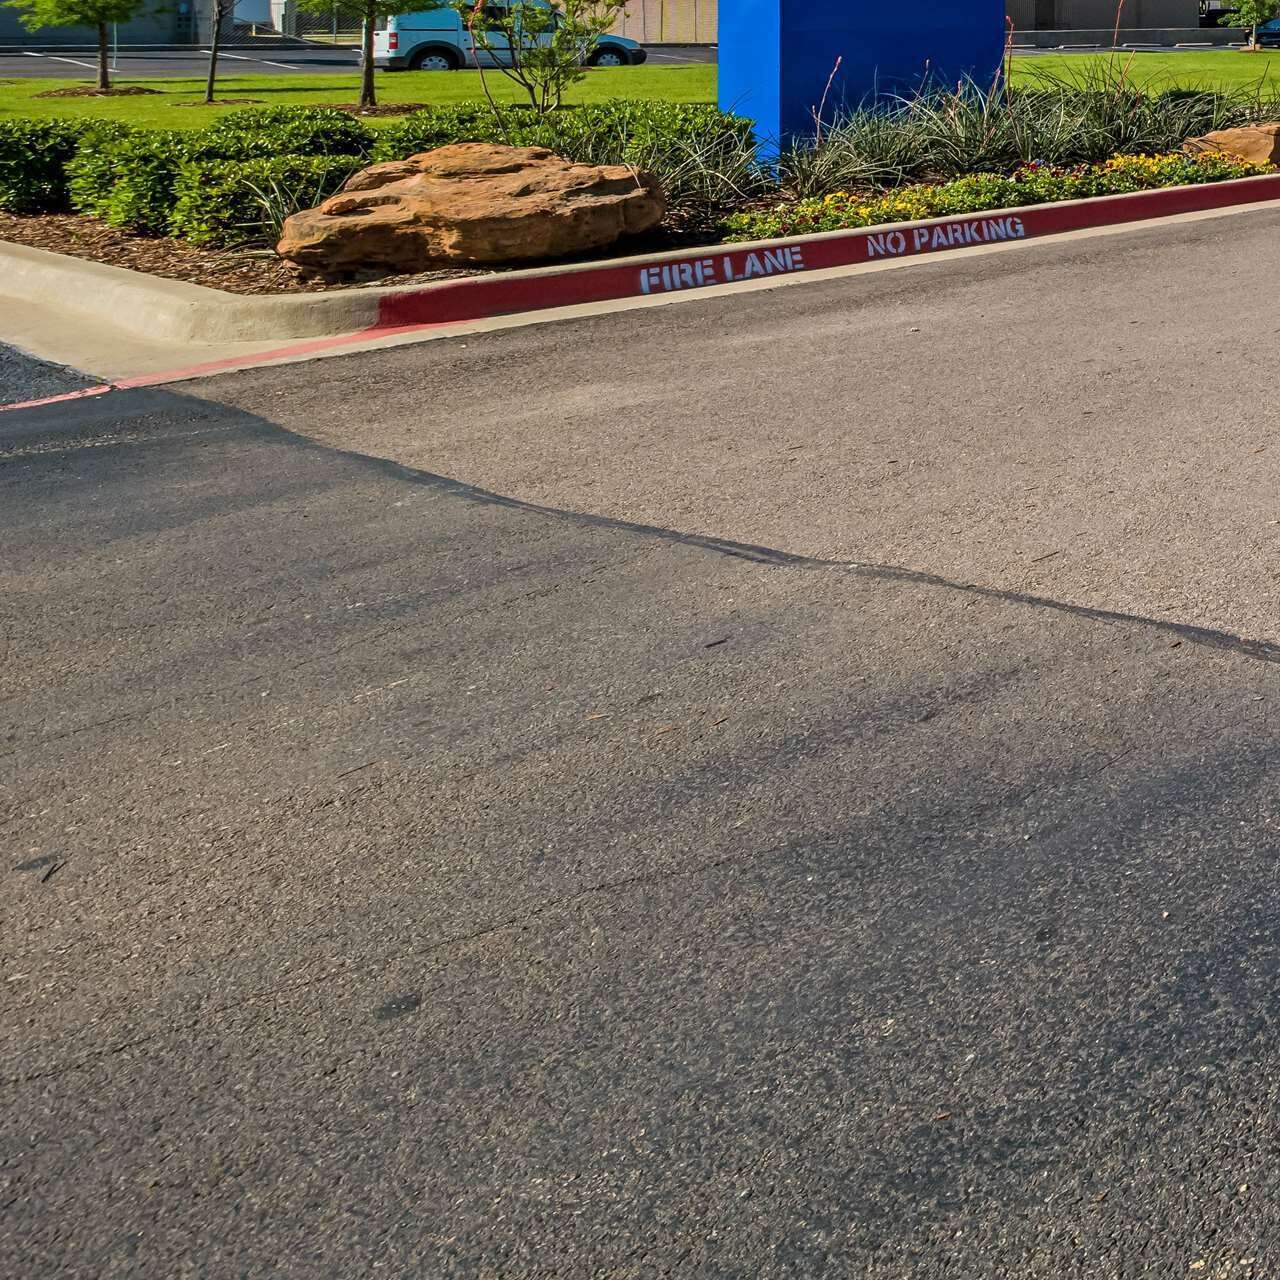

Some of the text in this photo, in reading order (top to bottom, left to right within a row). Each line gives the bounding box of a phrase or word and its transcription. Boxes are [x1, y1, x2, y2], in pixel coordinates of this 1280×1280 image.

[640, 216, 1025, 294] FIRE LANE NO PARKING
